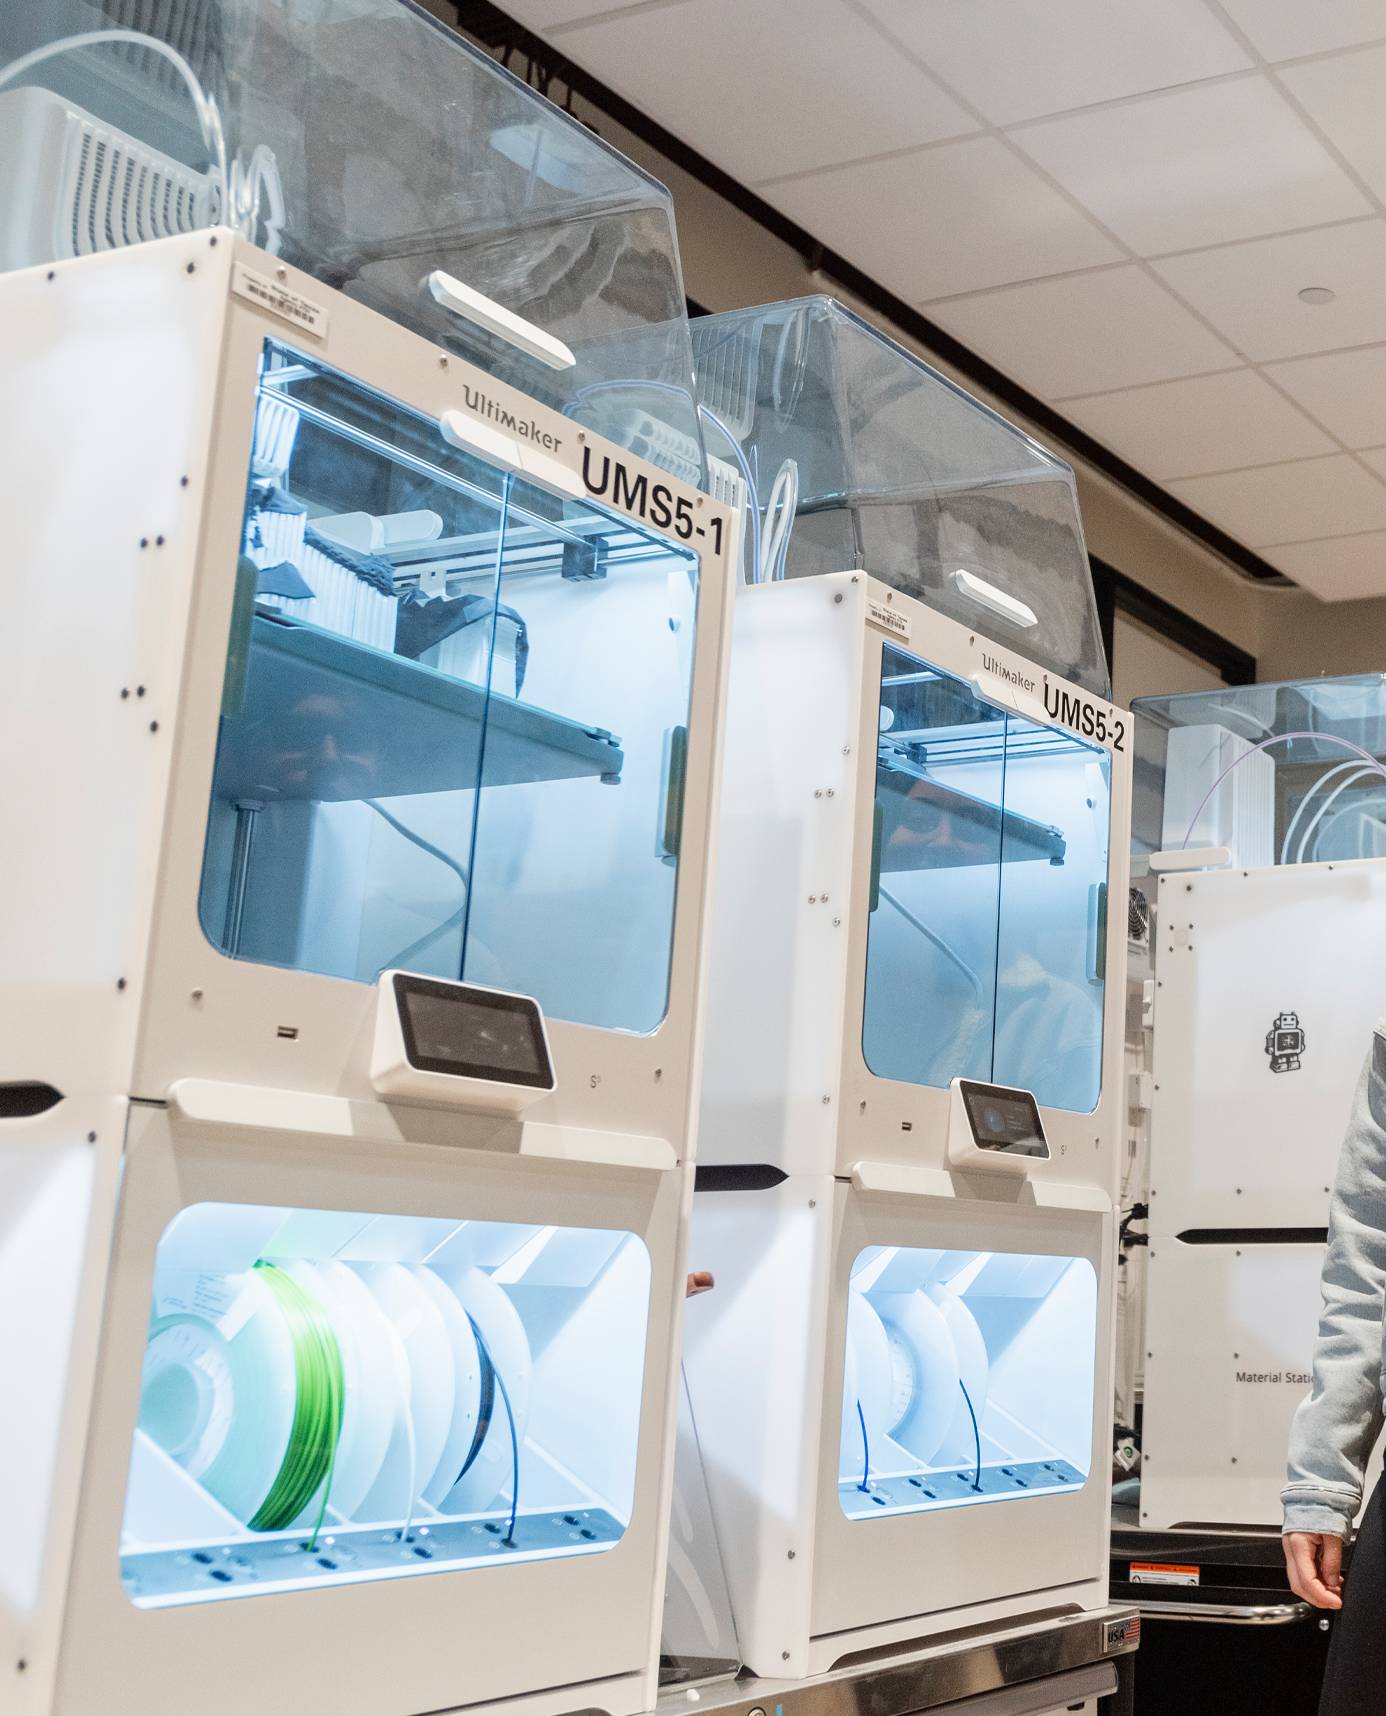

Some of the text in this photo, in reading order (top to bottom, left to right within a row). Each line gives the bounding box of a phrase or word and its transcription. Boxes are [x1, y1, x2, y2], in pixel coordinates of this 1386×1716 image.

[462, 384, 563, 453] Ultimaker
[582, 446, 723, 556] UMS5-1
[982, 653, 1036, 693] Ultimaker
[1043, 682, 1125, 752] UMS5-2
[1235, 1371, 1282, 1383] Material
[1107, 1628, 1125, 1643] USA
